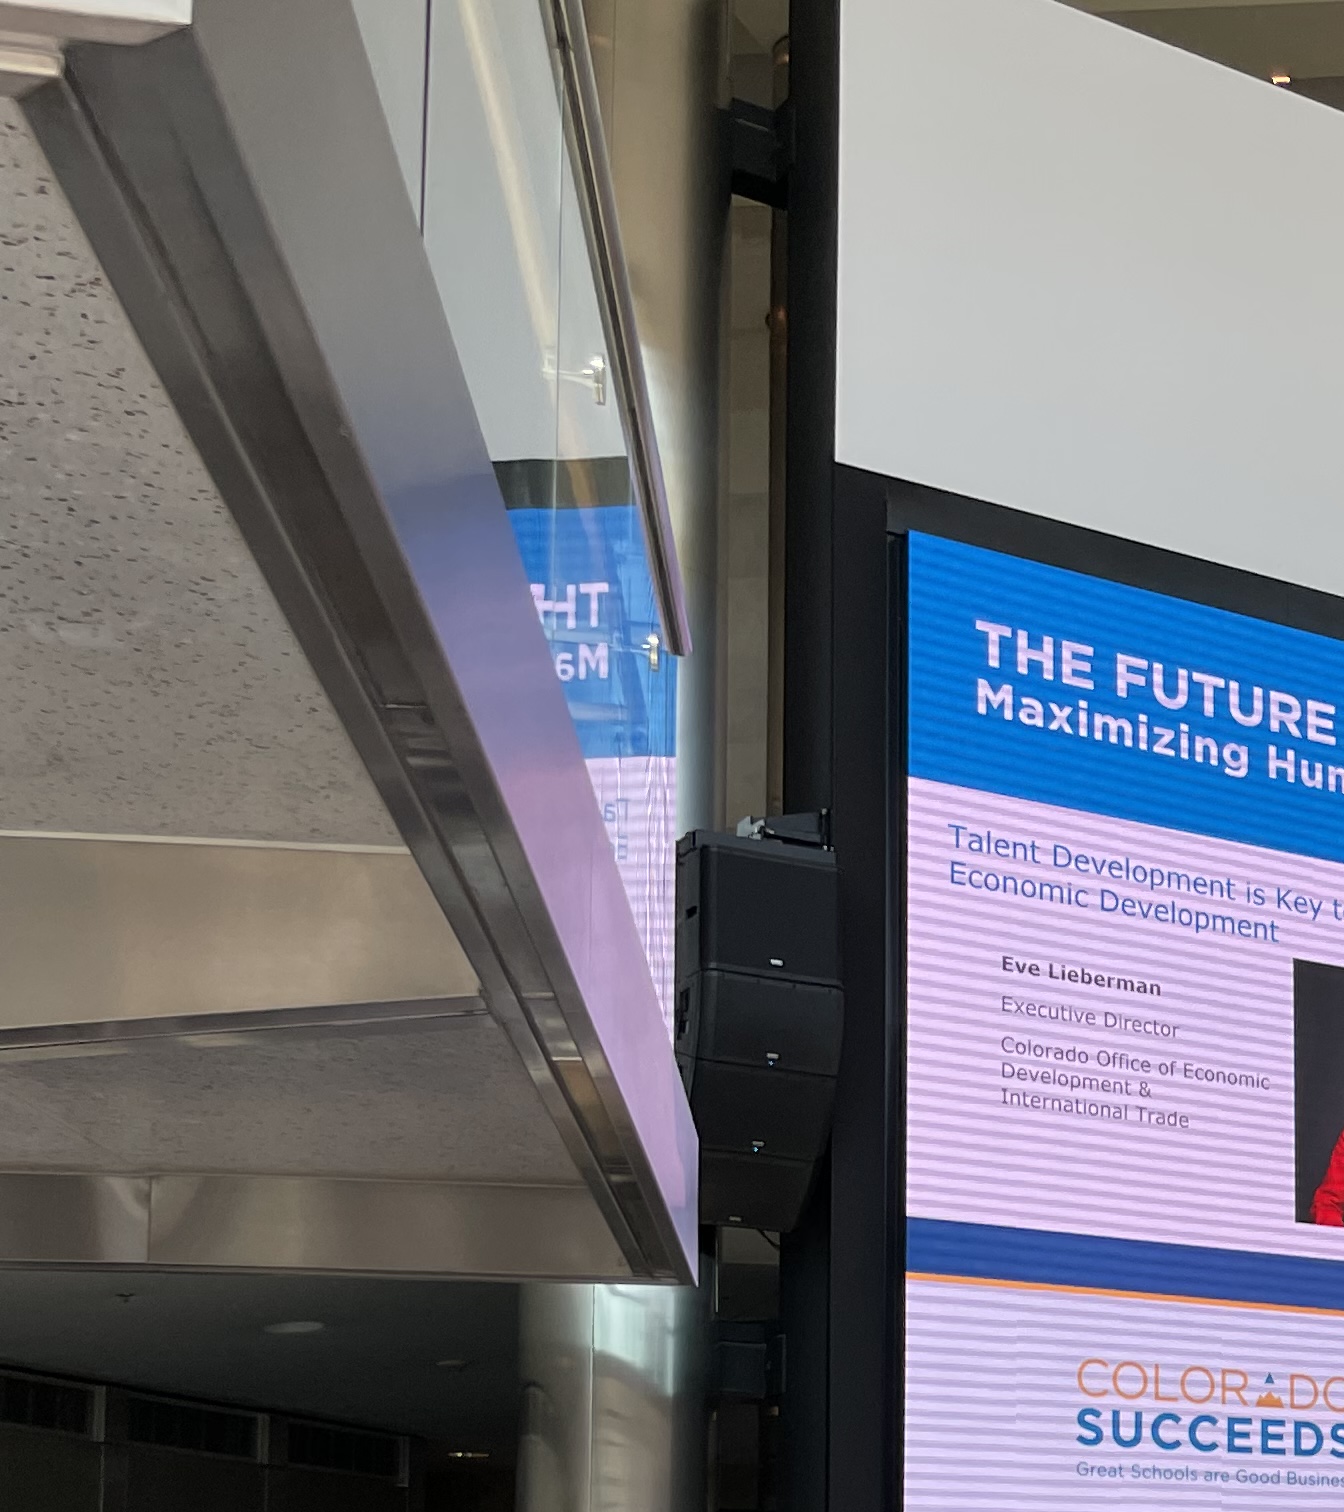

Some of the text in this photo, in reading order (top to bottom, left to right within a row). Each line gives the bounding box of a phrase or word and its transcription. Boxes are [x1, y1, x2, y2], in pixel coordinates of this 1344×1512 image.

[975, 619, 1094, 690] THE
[1116, 652, 1337, 746] FUTURE
[976, 678, 1249, 778] Maximizing
[948, 823, 1041, 864] Talent
[1053, 843, 1236, 900] Development
[1246, 881, 1266, 906] is
[1276, 886, 1323, 921] Key
[950, 860, 1279, 943] Economic Development
[1002, 955, 1162, 997] Eve Lieberman
[1001, 996, 1180, 1039] Executive Director
[1001, 1036, 1271, 1090] Colorado Office of Economic
[1002, 1062, 1152, 1098] Development &
[1001, 1088, 1190, 1129] International Trade
[1076, 1461, 1123, 1478] Great
[1131, 1464, 1198, 1481] Schools
[1203, 1471, 1230, 1482] are
[1235, 1469, 1281, 1485] Good
